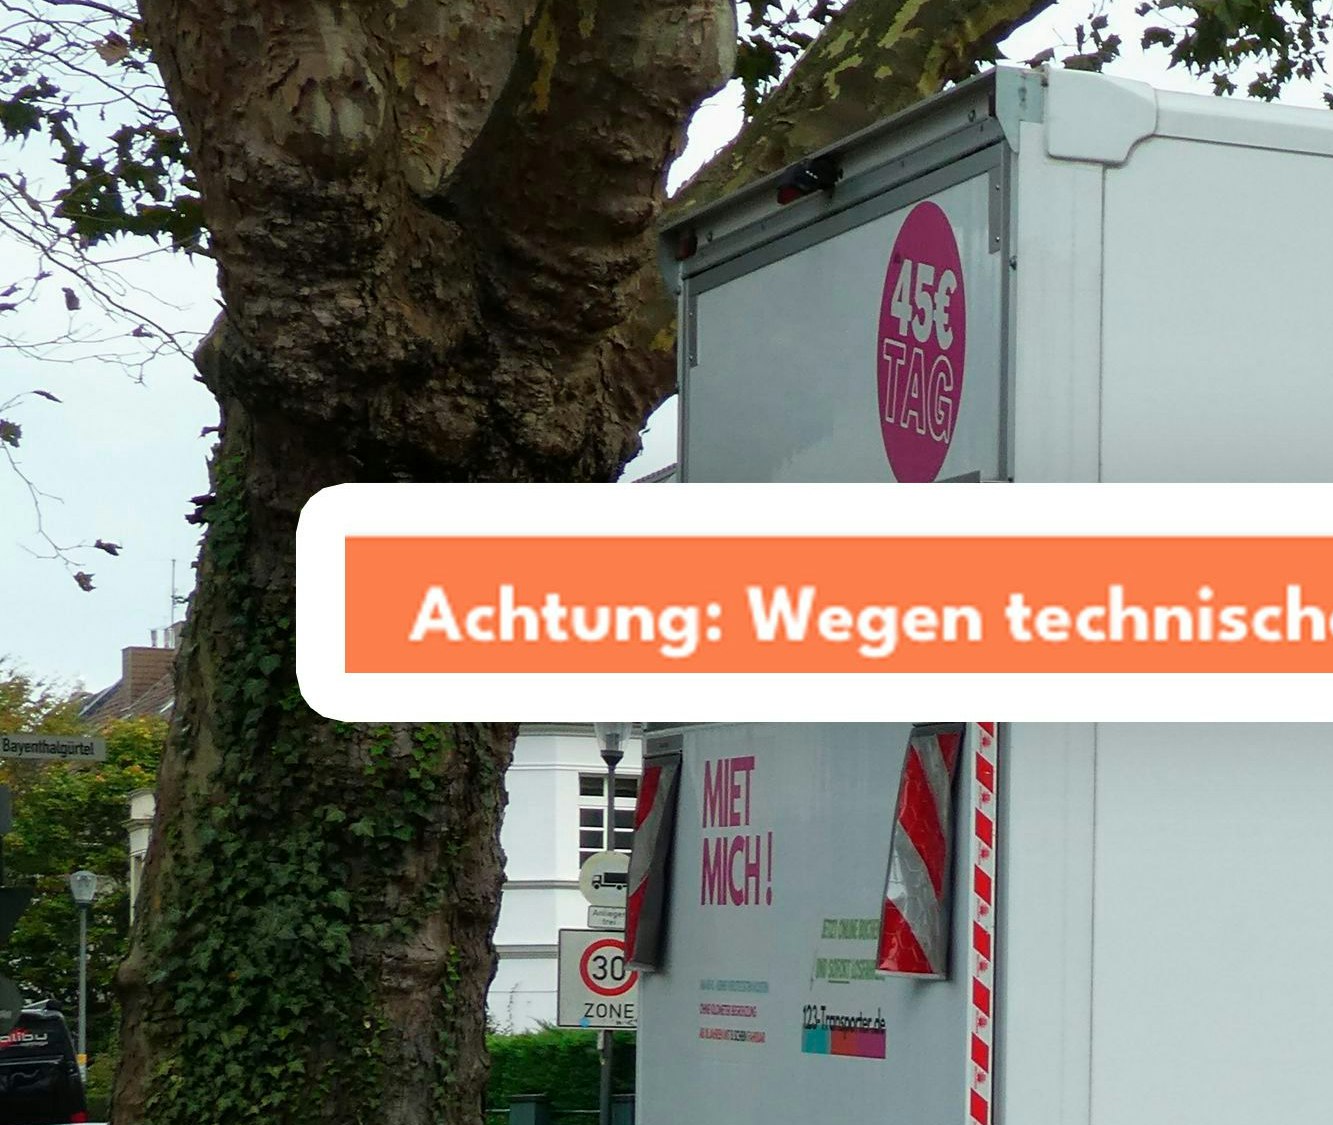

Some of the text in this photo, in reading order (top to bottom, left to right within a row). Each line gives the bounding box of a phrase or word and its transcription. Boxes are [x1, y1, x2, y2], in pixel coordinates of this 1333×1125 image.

[890, 258, 957, 350] 45€
[883, 337, 954, 444] TAG
[2, 738, 94, 757] Bayenthalgürtel
[702, 756, 755, 828] MIET
[592, 955, 625, 981] 30
[584, 1002, 635, 1019] ZONE
